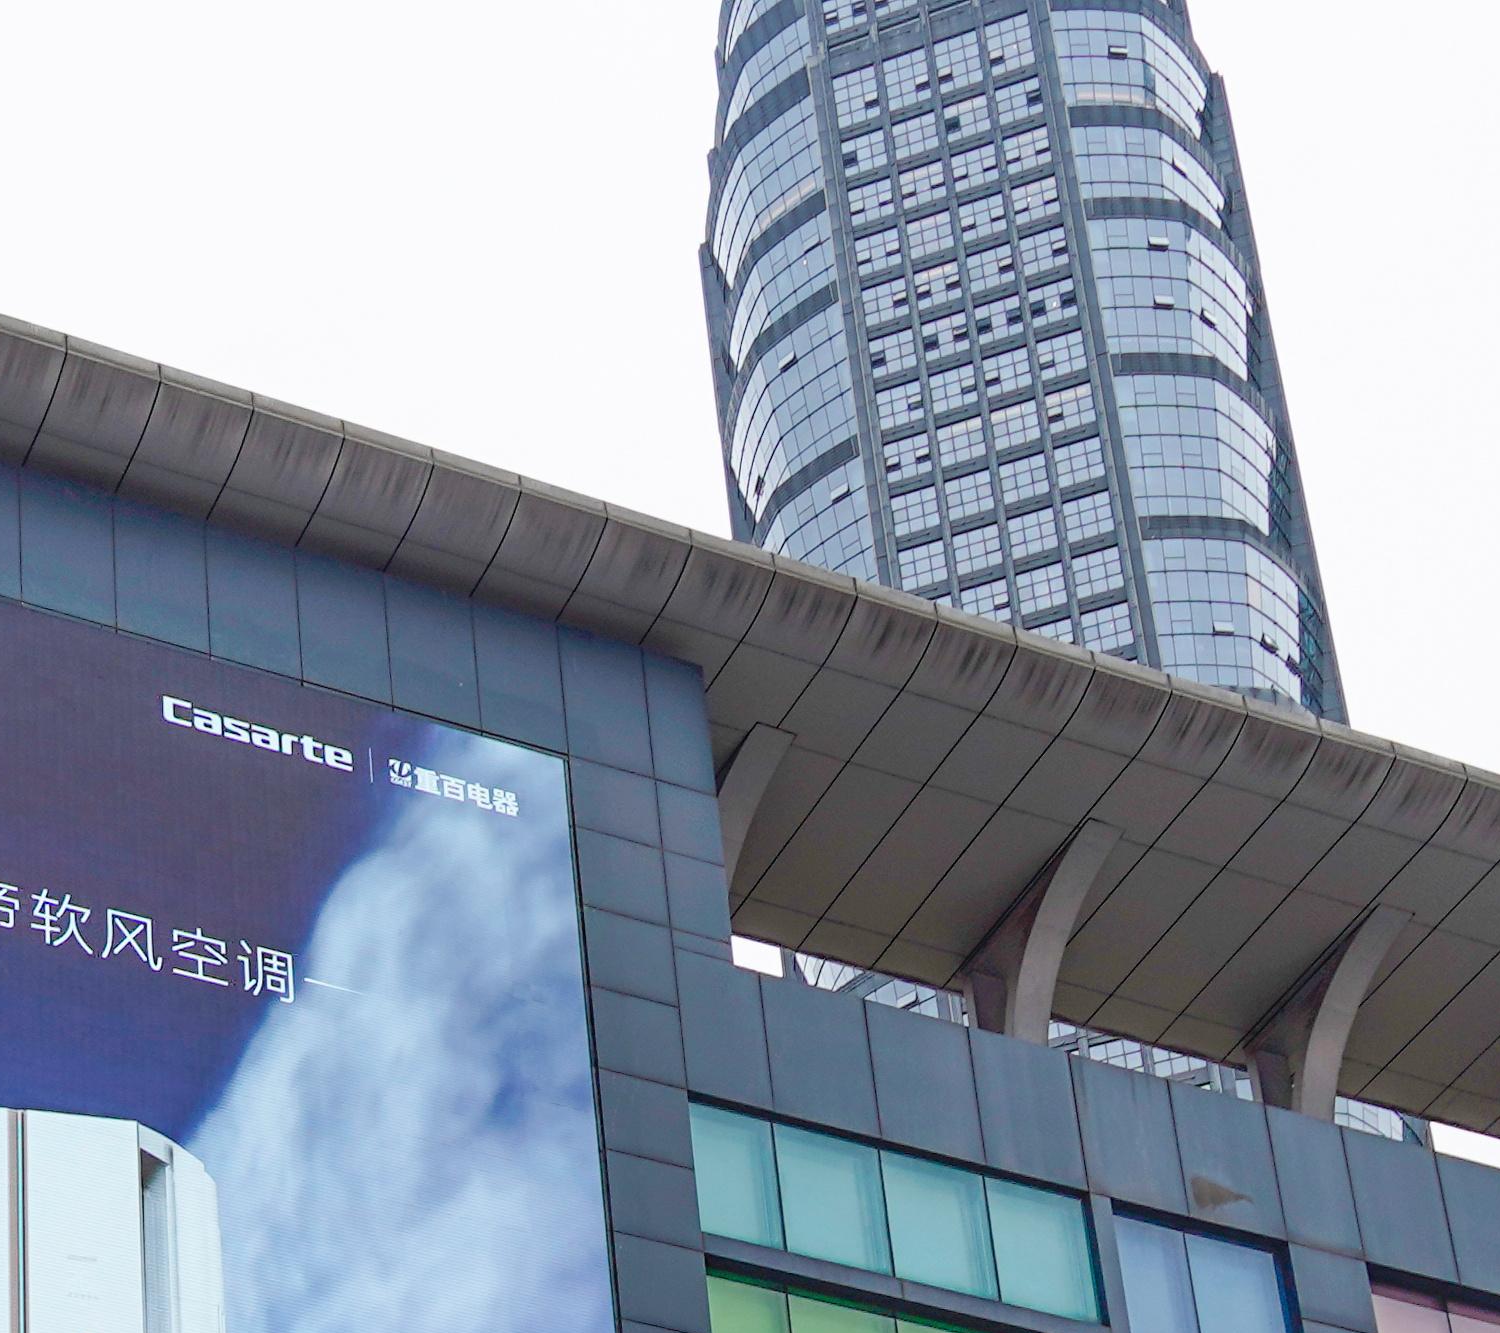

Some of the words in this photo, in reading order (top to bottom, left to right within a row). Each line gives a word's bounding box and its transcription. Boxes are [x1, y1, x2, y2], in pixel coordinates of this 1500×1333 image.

[161, 693, 355, 774] Casarte
[415, 764, 521, 818] 重百电器
